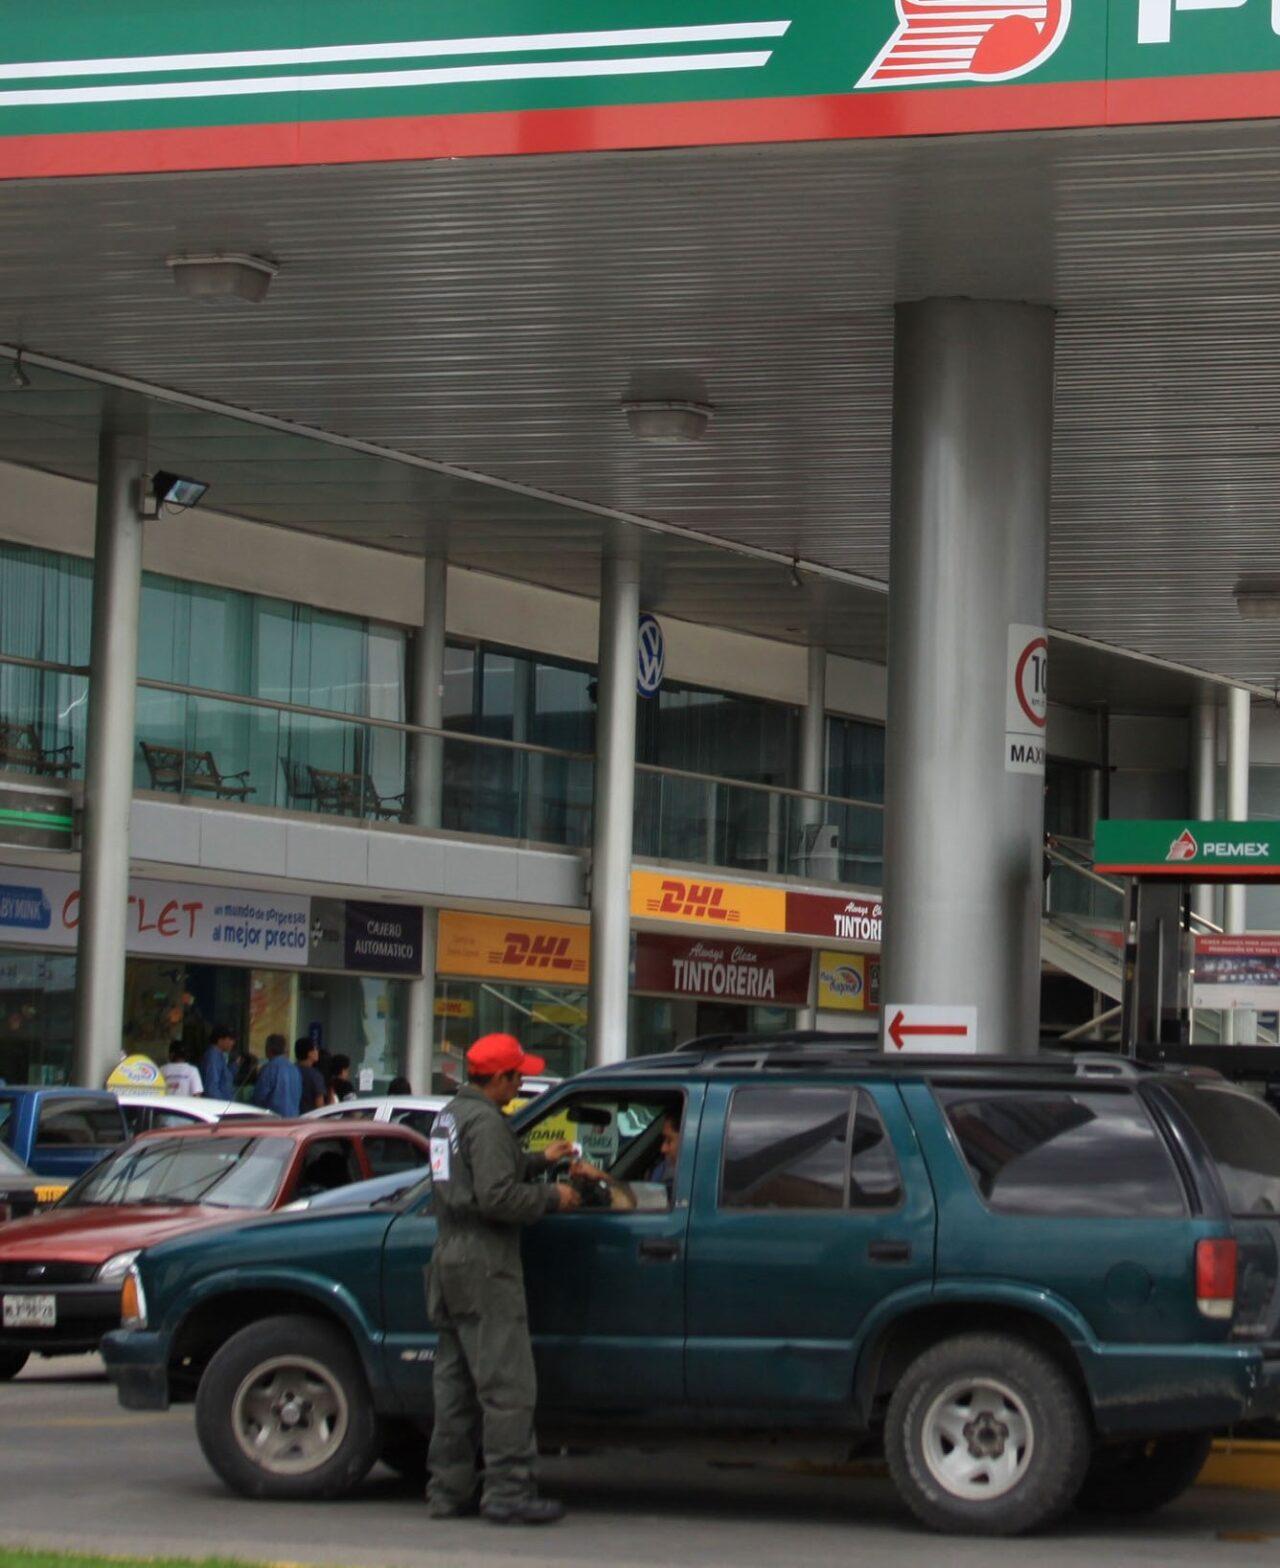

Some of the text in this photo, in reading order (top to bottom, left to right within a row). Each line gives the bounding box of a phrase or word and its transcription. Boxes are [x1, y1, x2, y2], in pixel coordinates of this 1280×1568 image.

[1203, 843, 1269, 856] PEMEX
[224, 904, 255, 918] mundo
[659, 880, 729, 920] DHL
[213, 925, 222, 941] al
[224, 921, 261, 949] mejor
[265, 927, 306, 950] precio
[366, 920, 401, 936] CAJERO
[834, 914, 881, 940] TINTOR
[354, 939, 414, 959] AUTOMATICO
[502, 932, 573, 969] DHL
[689, 944, 758, 962] Always Clean
[672, 959, 776, 999] TINTORERIA
